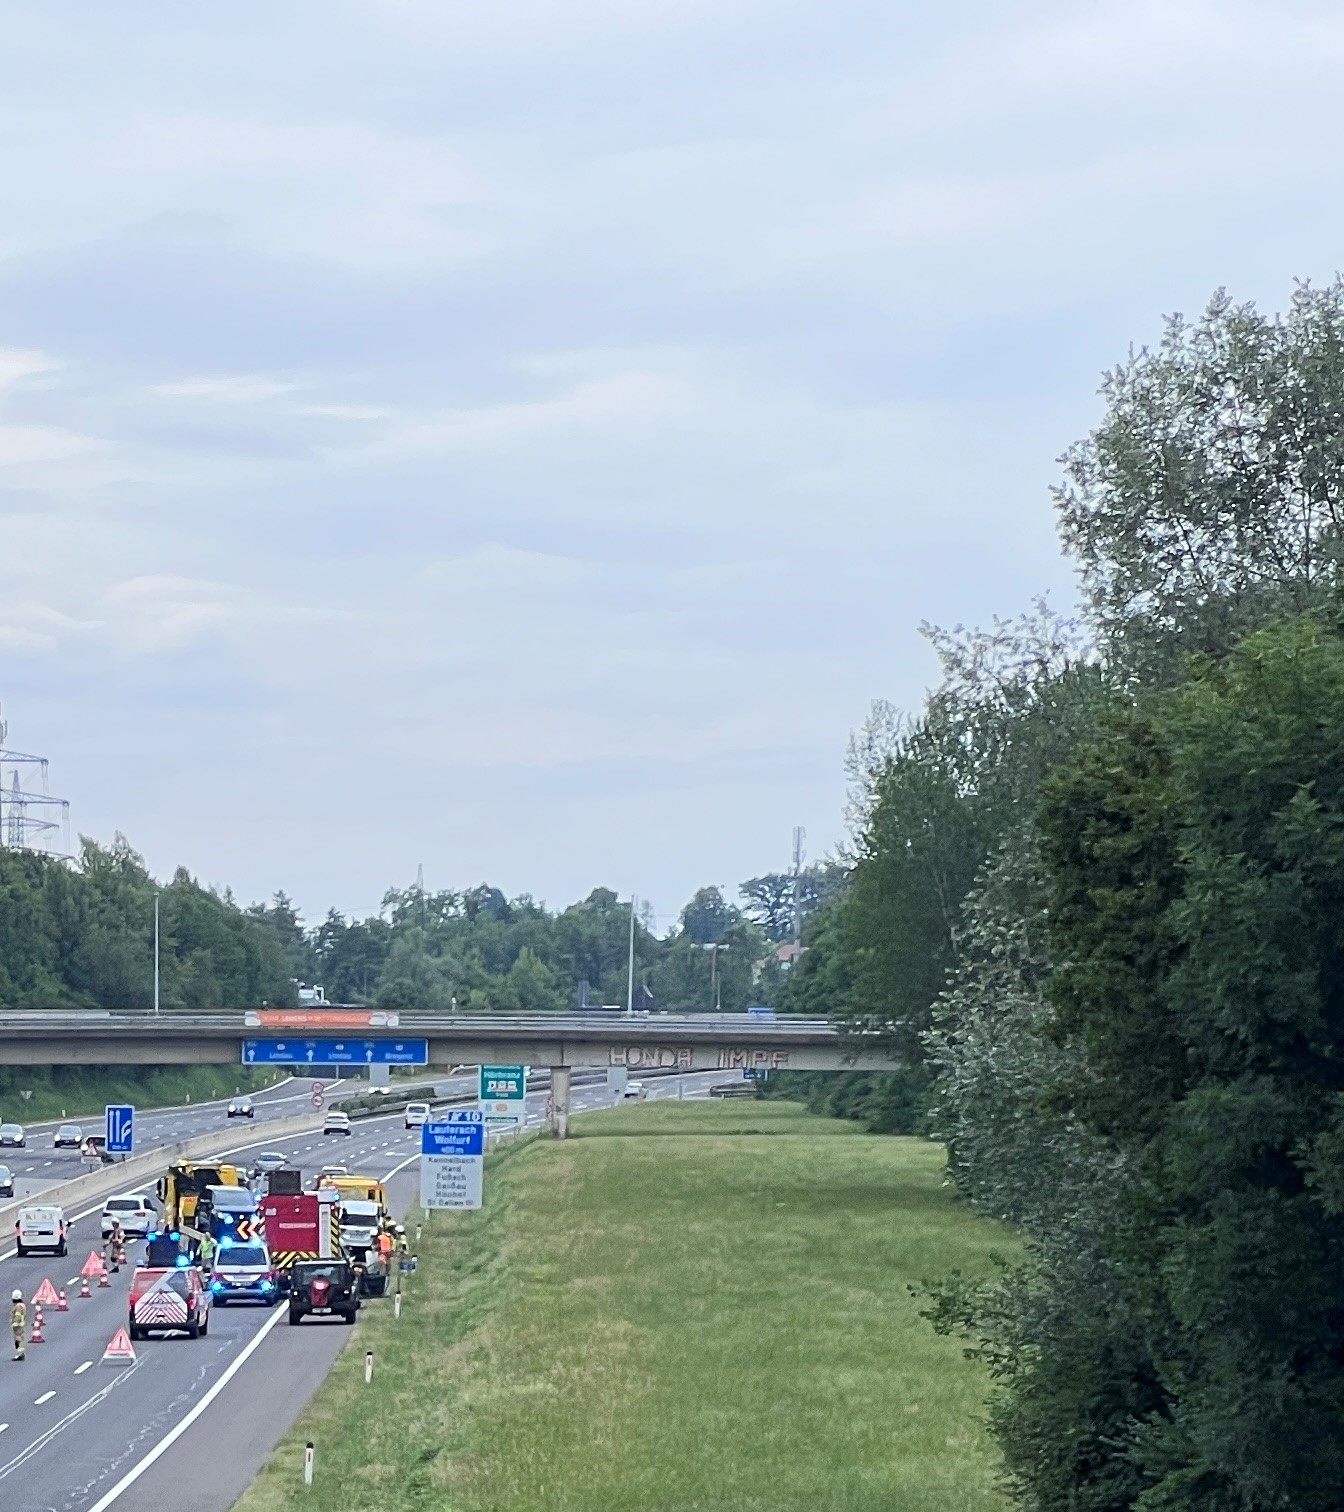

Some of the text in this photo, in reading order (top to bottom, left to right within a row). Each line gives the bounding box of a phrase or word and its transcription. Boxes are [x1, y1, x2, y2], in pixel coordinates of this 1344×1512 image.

[610, 1047, 692, 1069] HONDA
[466, 1111, 481, 1122] 10
[428, 1124, 477, 1135] Lauterach
[434, 1135, 471, 1145] Wolfurt
